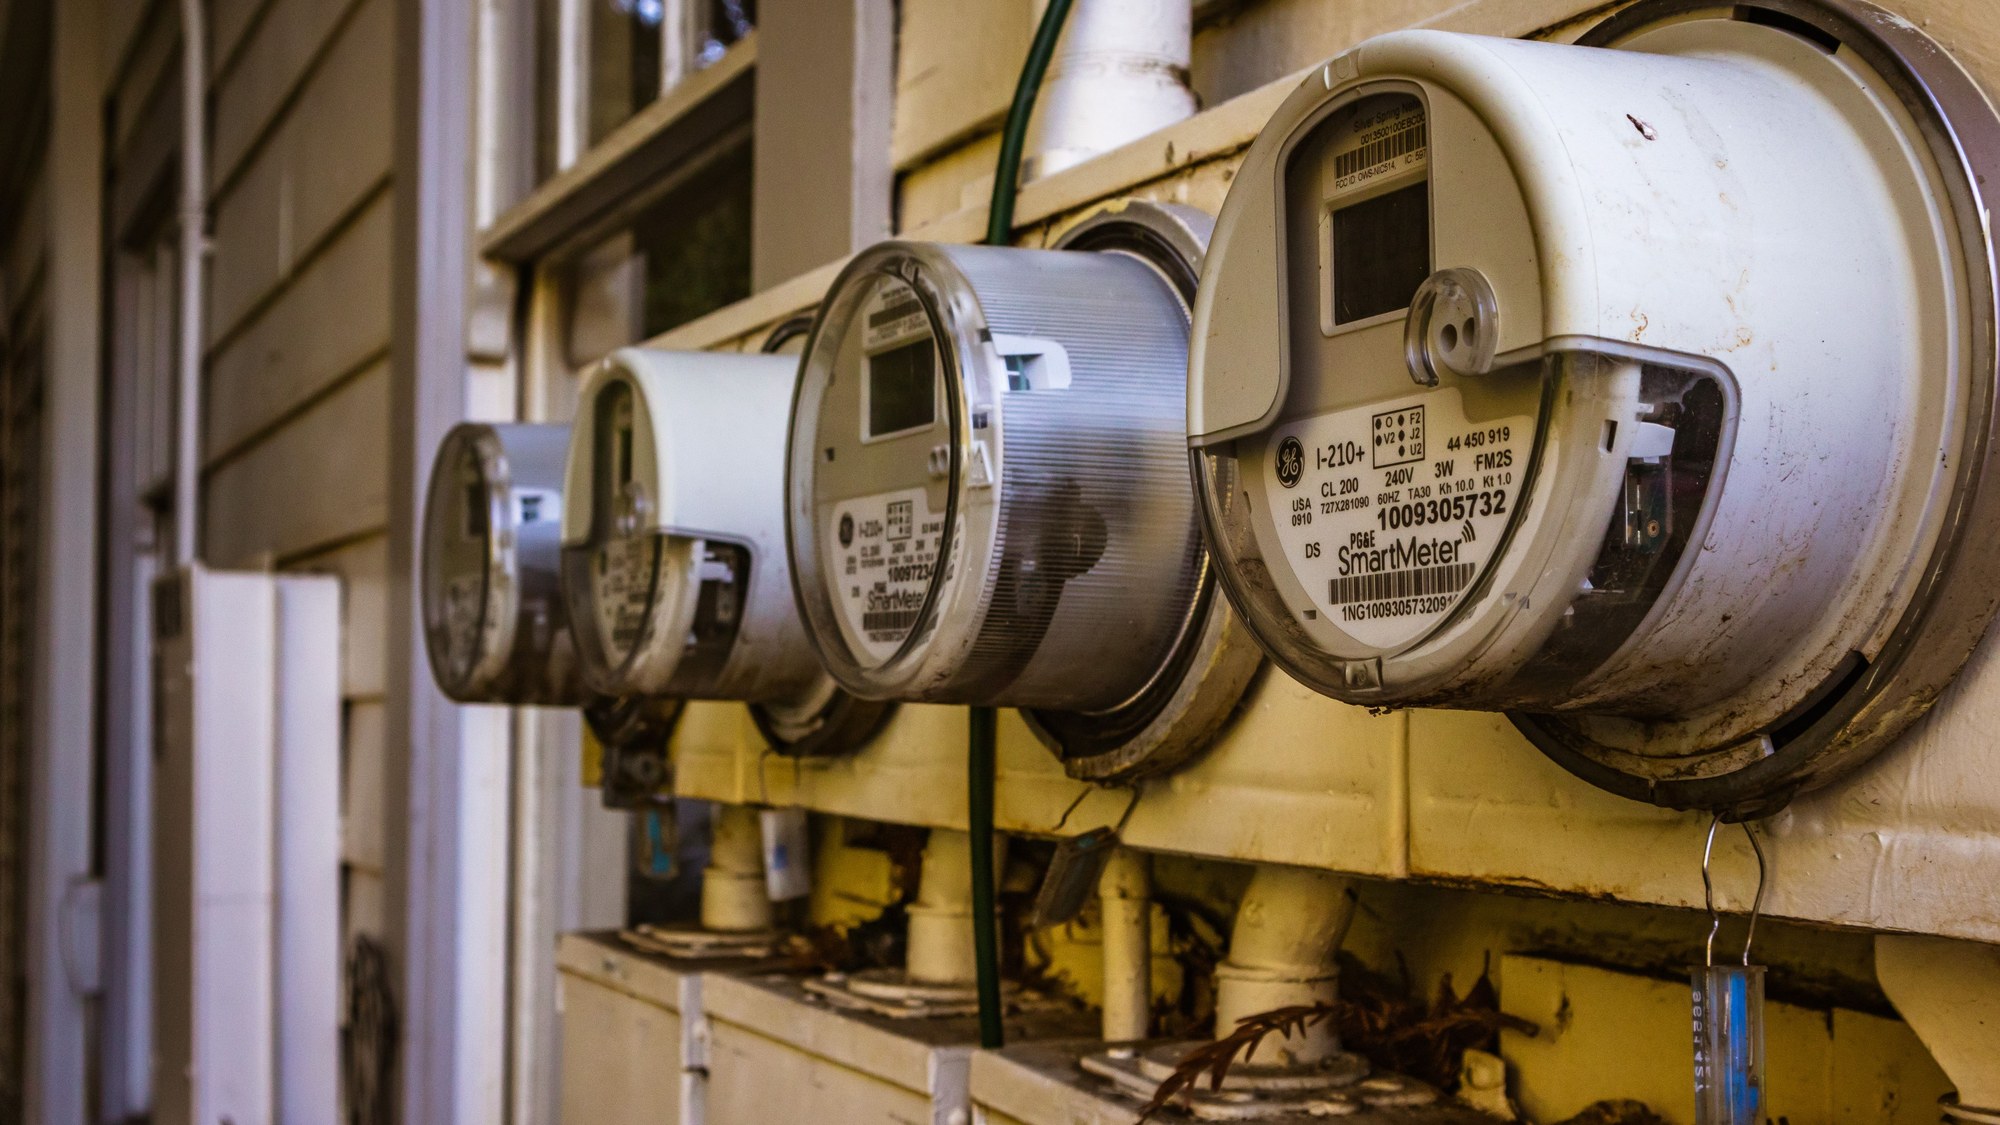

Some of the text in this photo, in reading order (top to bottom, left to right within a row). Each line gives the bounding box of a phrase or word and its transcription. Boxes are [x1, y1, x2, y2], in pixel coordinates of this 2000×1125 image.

[1376, 107, 1400, 126] Spring
[1336, 178, 1348, 189] FCC
[1409, 412, 1421, 425] F2
[1384, 428, 1420, 444] V2 J2
[1447, 427, 1510, 451] 44 450 919
[1316, 441, 1365, 470] I-210+
[1409, 443, 1422, 456] U2
[1385, 449, 1512, 488] 240V 3W FM2S
[1320, 472, 1512, 515] 727X281090 60HZ TA30 Kh 10.0 Kt 1.0
[1321, 477, 1359, 498] CL 200
[1292, 498, 1312, 512] USA
[1377, 489, 1507, 531] 1009305732
[1291, 514, 1312, 527] 0910
[1350, 530, 1376, 550] PG&E
[1305, 542, 1321, 559] DS
[1338, 536, 1462, 576] SmartMeter
